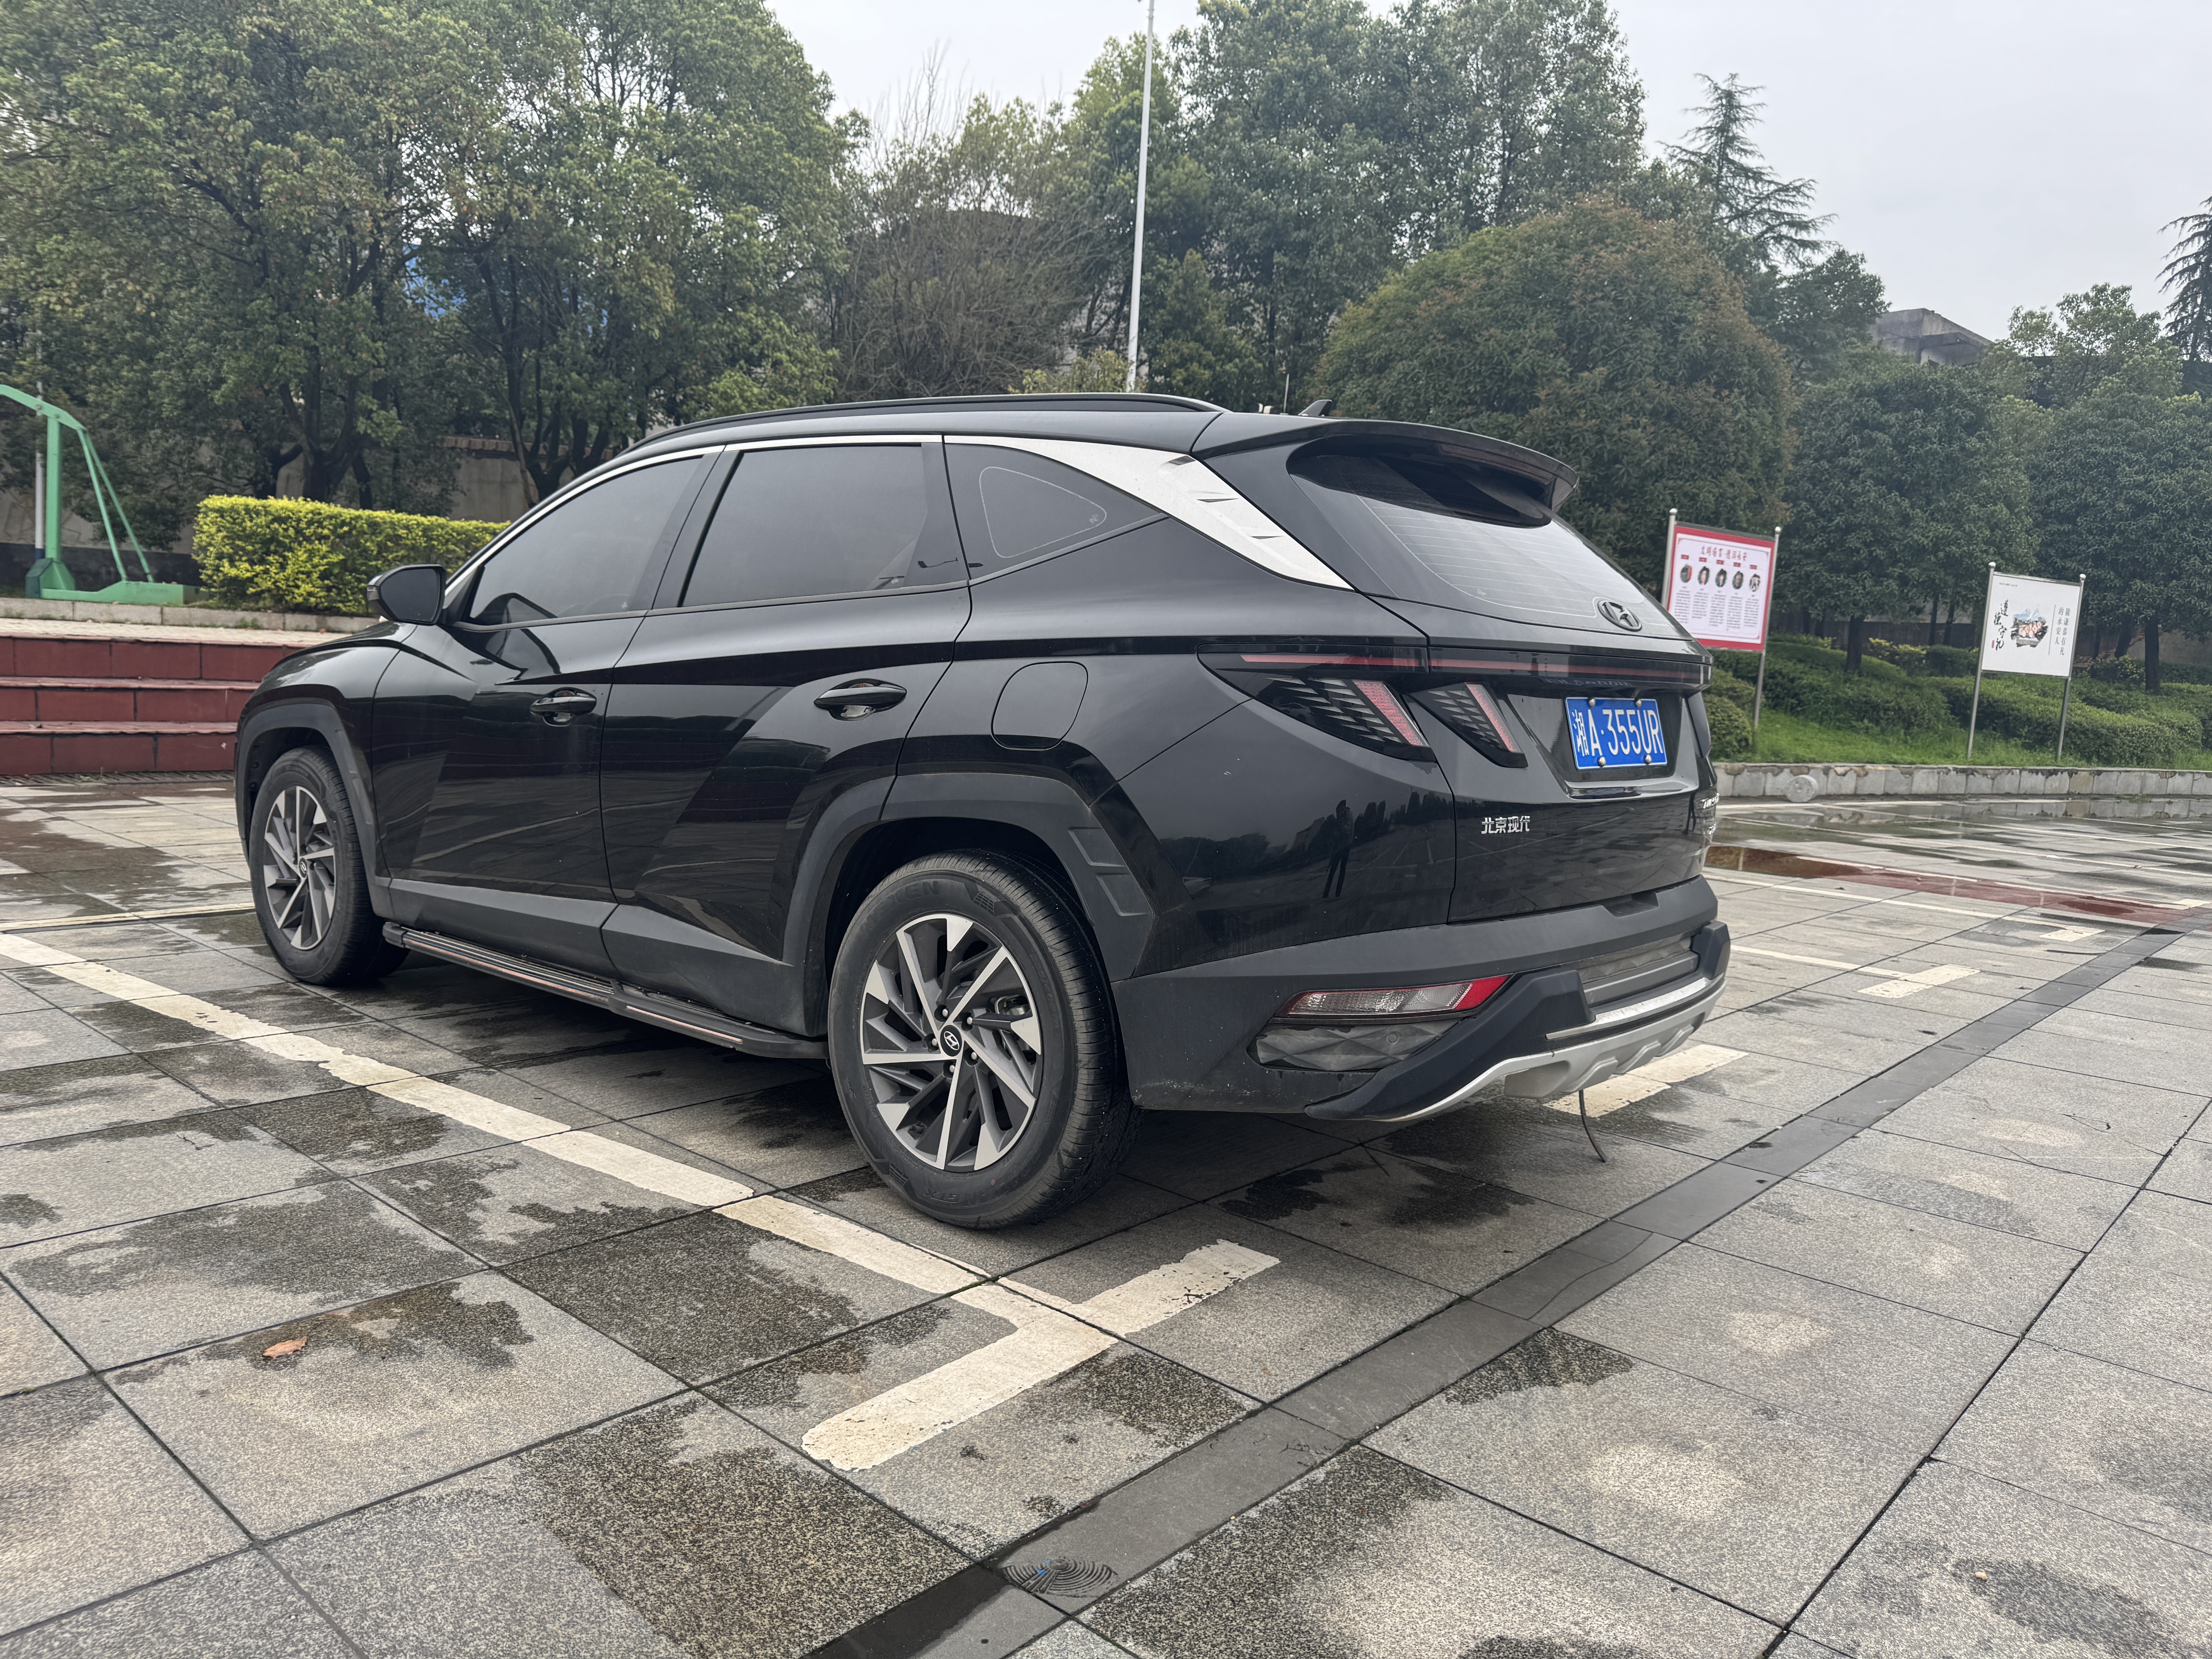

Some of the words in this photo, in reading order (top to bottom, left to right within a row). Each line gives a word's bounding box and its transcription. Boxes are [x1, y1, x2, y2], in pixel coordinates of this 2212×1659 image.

[2054, 607, 2064, 645] 的永安人
[1481, 816, 1530, 834] 北京现代
